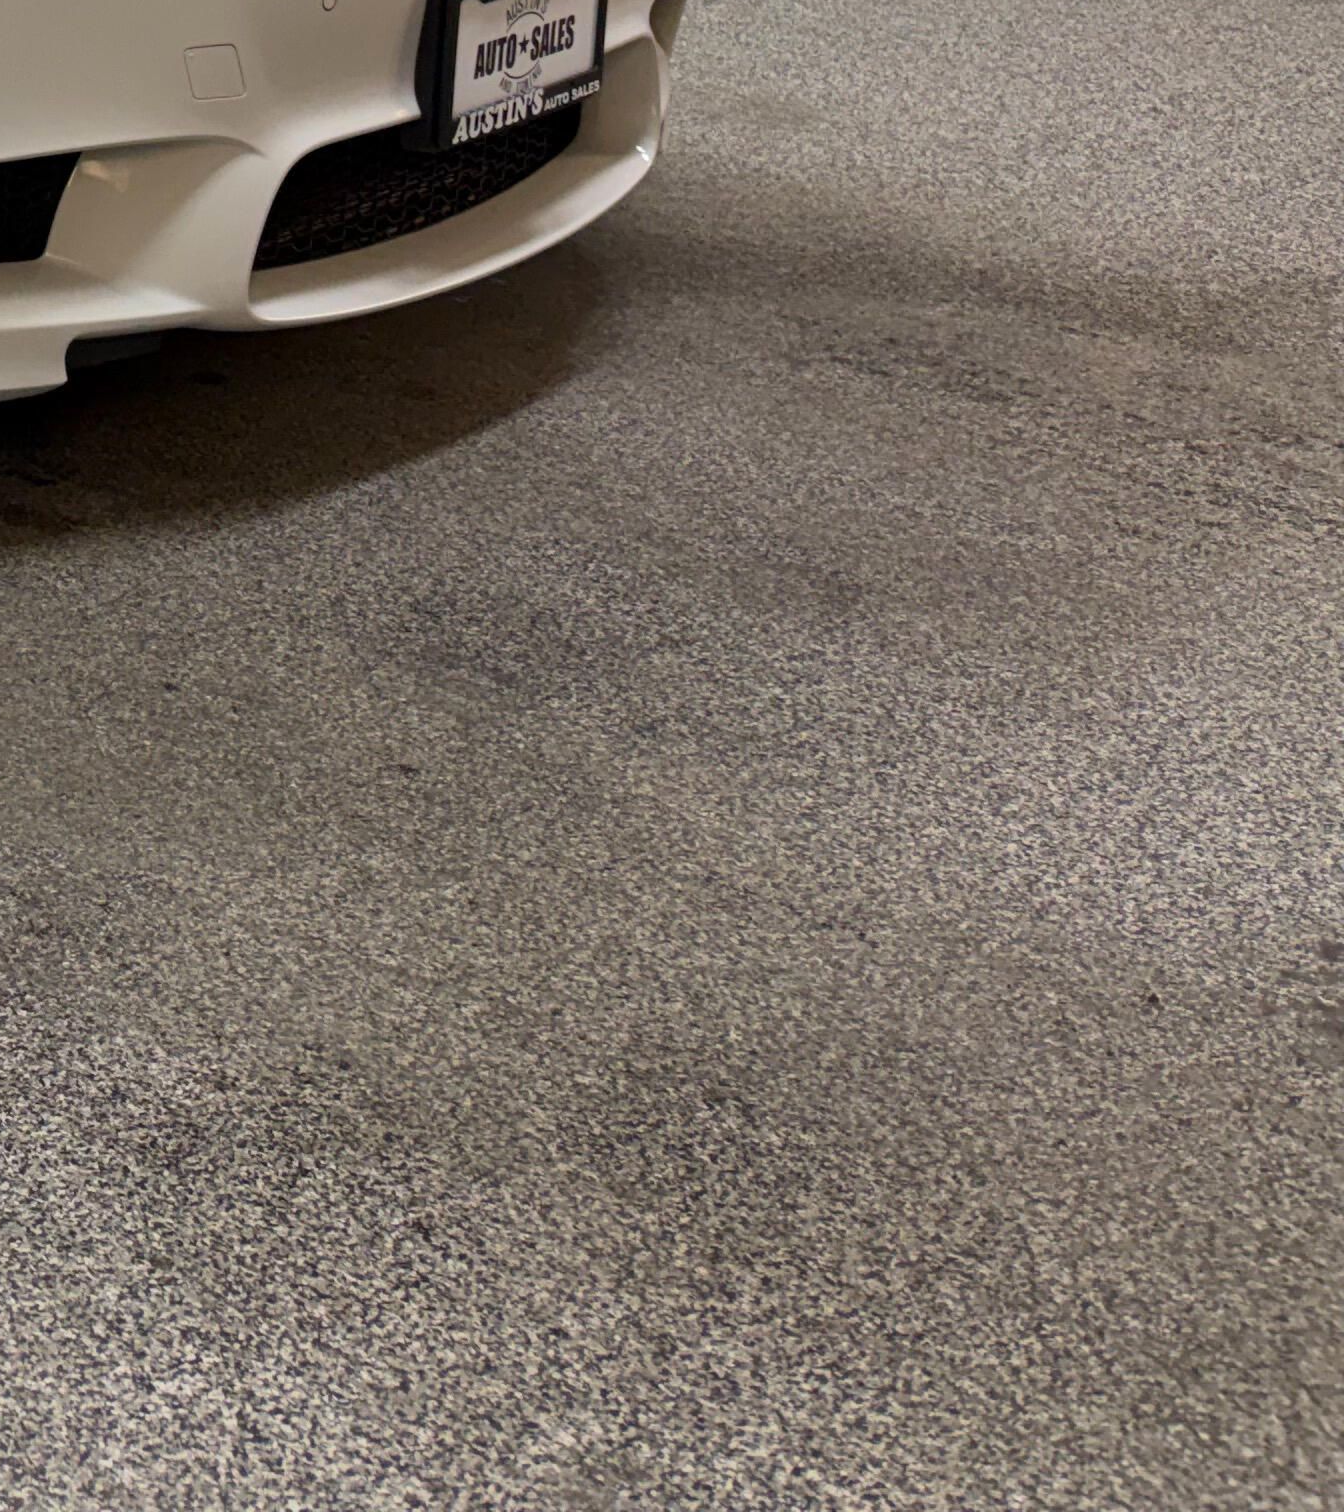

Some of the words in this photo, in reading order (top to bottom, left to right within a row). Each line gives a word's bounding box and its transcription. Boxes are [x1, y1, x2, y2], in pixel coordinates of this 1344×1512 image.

[473, 33, 518, 80] AUTO
[530, 14, 576, 62] SALES
[451, 88, 545, 145] AUSTIN'S
[544, 92, 569, 112] AUTO
[571, 80, 601, 102] SALES
